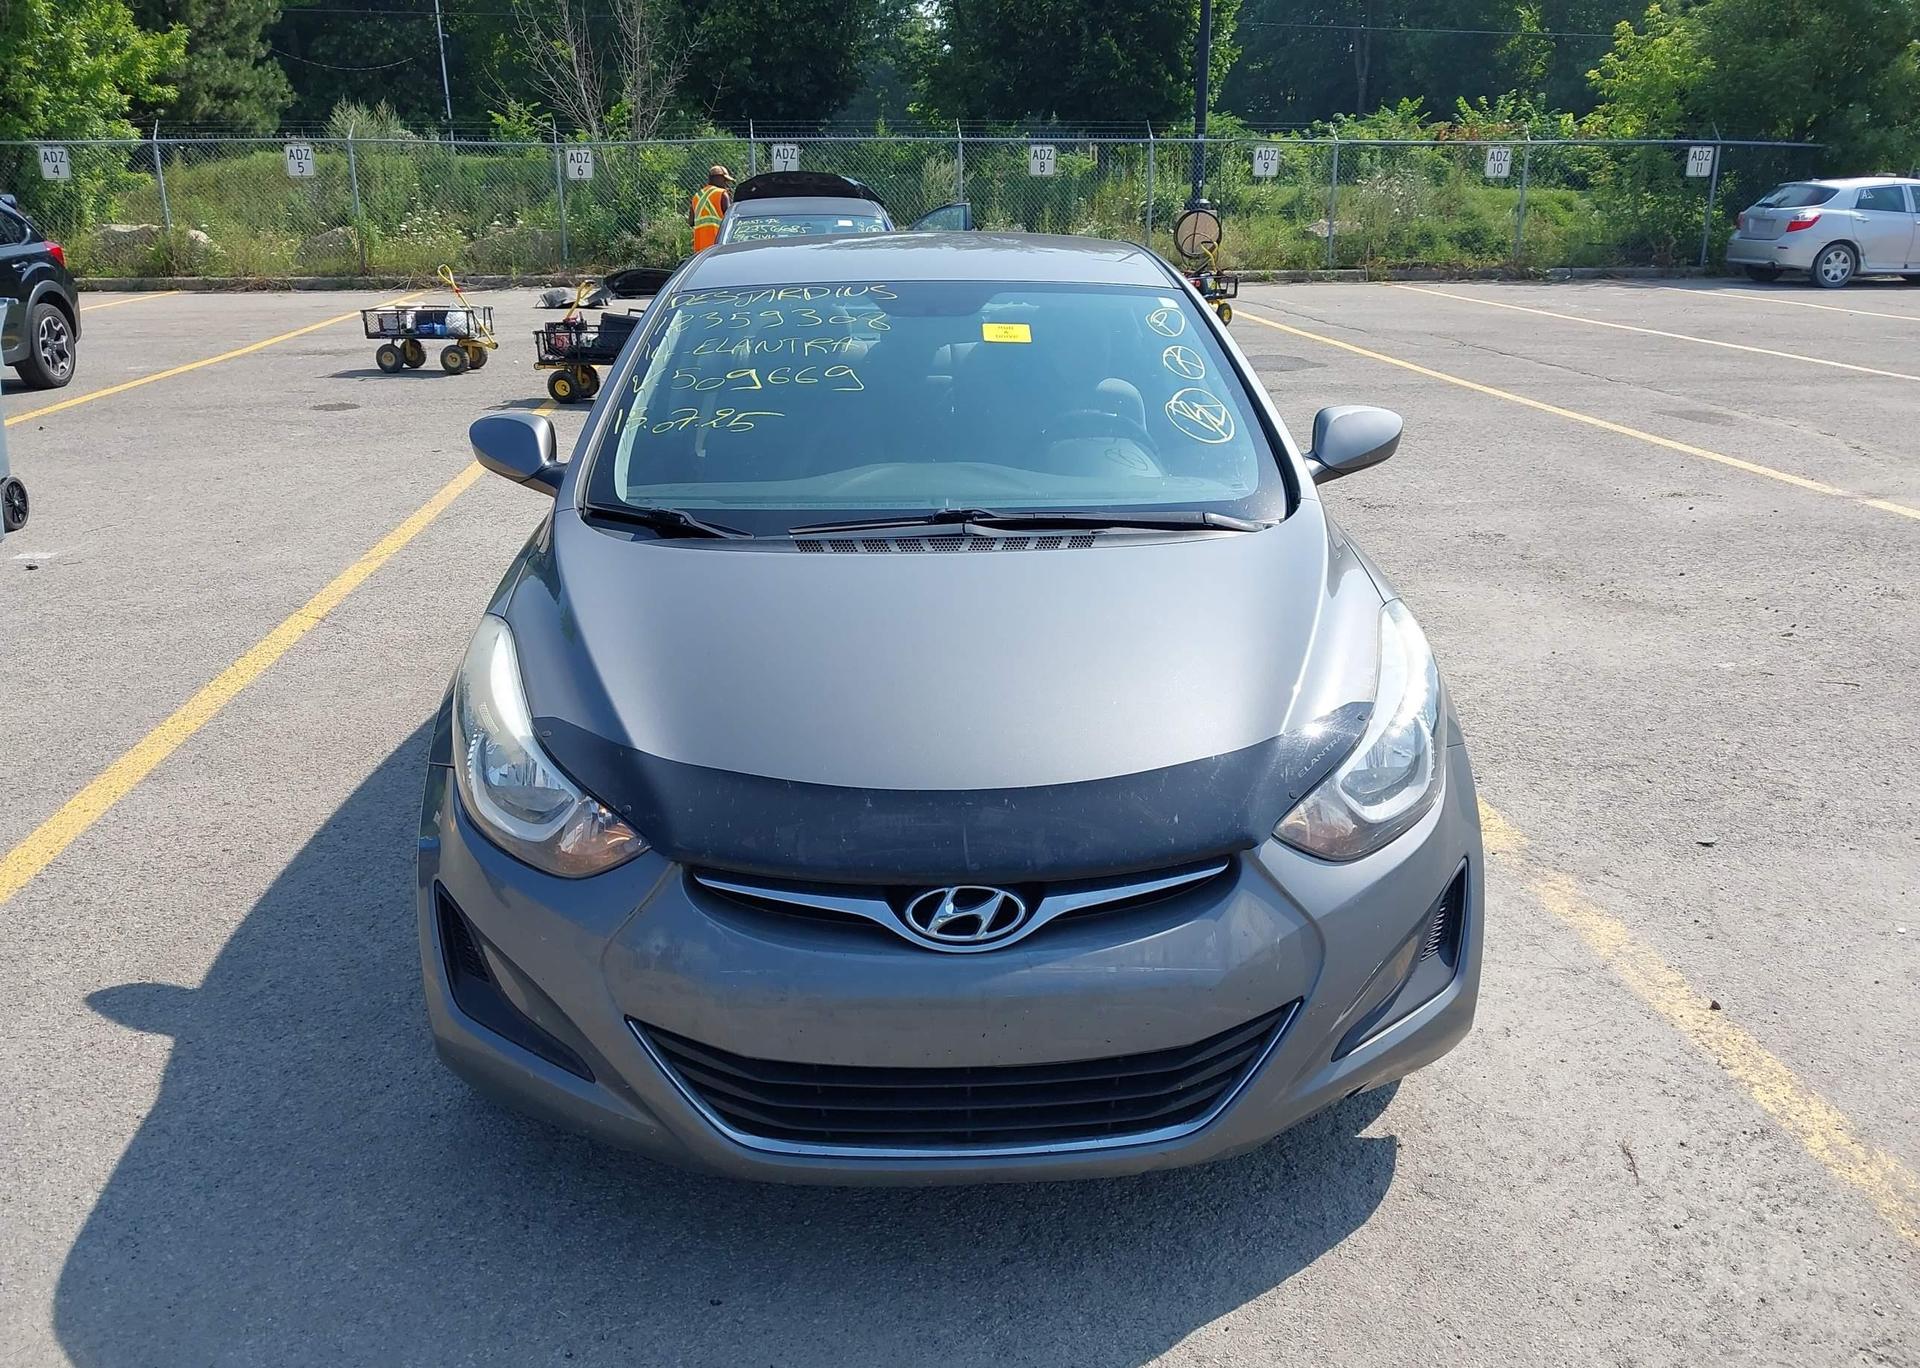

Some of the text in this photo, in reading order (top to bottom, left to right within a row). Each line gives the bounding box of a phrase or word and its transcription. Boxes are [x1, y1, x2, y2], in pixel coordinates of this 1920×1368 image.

[43, 151, 66, 163] ADZ
[289, 149, 311, 160] ADZ
[569, 151, 590, 164] ADZ
[775, 148, 796, 160] ADZ
[1032, 150, 1053, 161] ADZ
[1257, 150, 1277, 161] ADZ
[1489, 151, 1509, 162] ADZ
[1691, 150, 1711, 161] ADZ
[52, 165, 60, 176] 4
[297, 162, 305, 174] 5
[577, 165, 584, 176] 6
[782, 161, 789, 171] 7
[1039, 162, 1046, 173] 8
[1263, 162, 1270, 173] 9
[1493, 163, 1503, 174] 10
[1696, 162, 1703, 174] 11
[671, 365, 865, 391] 509669
[1297, 734, 1346, 779] ELANTRA
